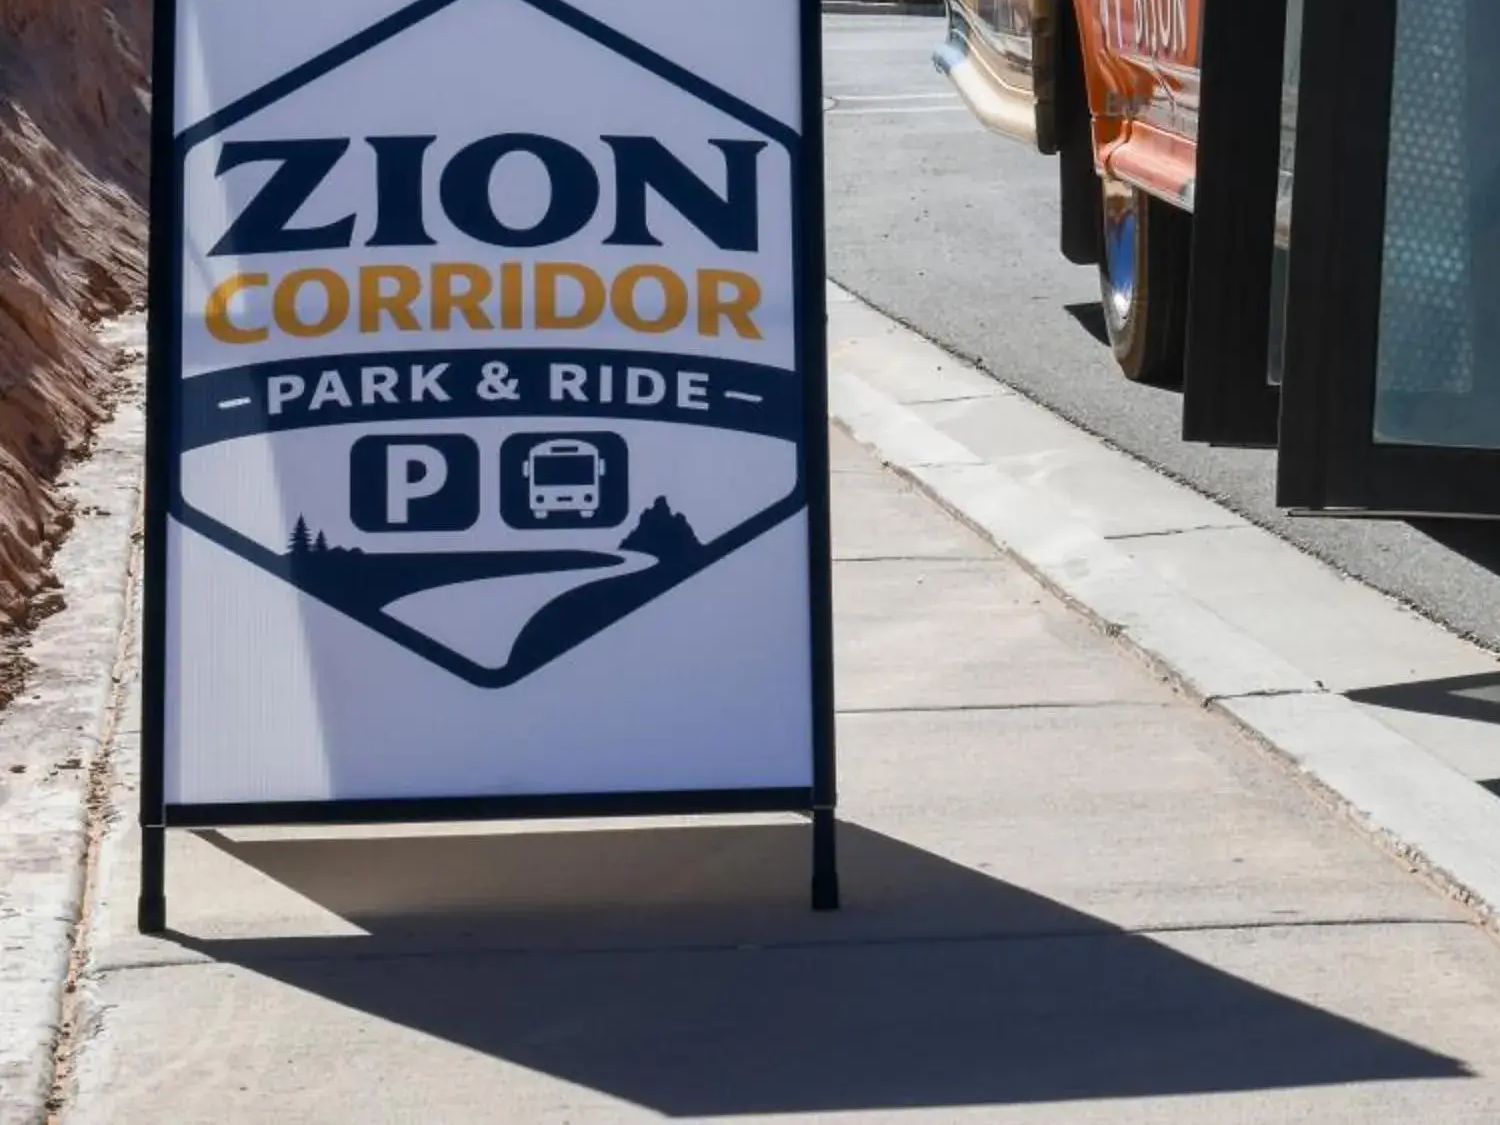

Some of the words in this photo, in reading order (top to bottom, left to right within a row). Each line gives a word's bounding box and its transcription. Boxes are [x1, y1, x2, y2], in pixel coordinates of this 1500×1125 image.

[207, 132, 769, 257] ZION
[205, 262, 763, 344] CORRIDOR
[268, 362, 450, 414] PARK
[477, 361, 520, 400] &
[550, 363, 710, 410] RIDE
[387, 444, 448, 524] P
